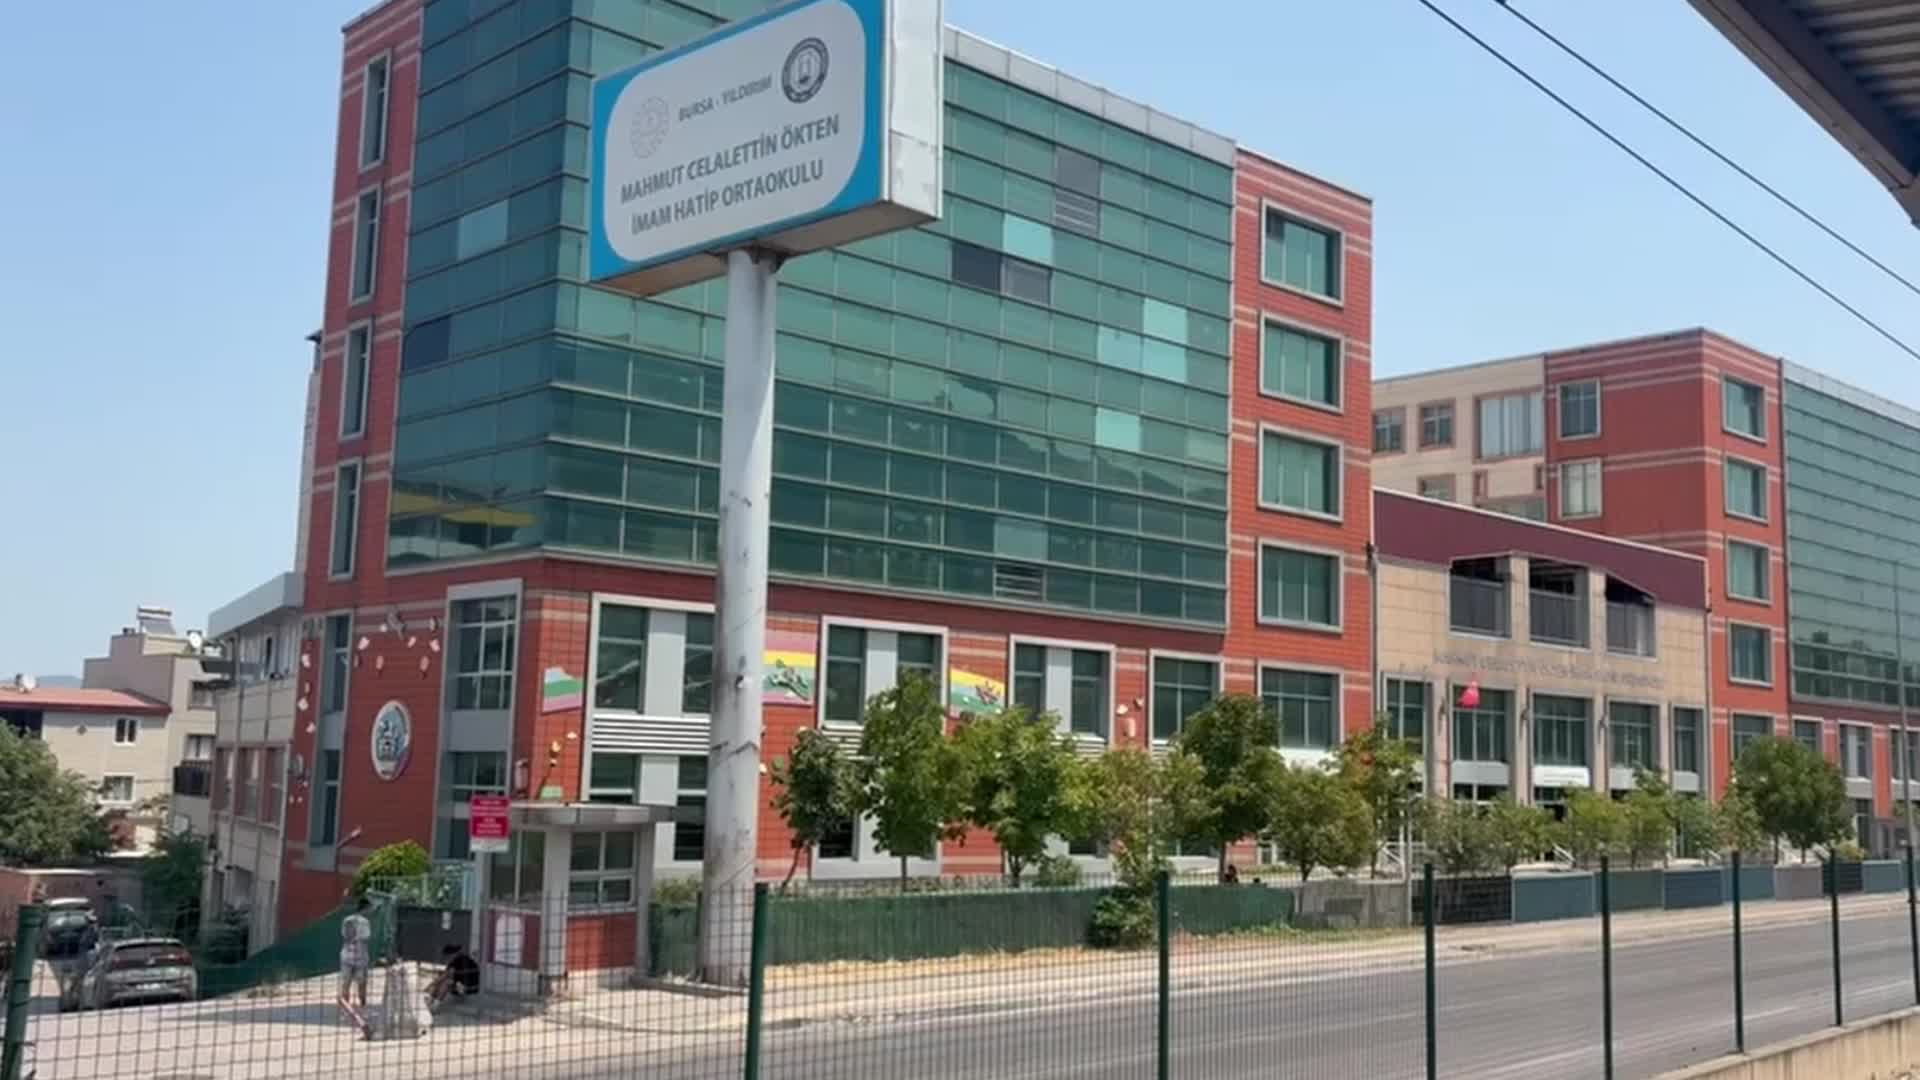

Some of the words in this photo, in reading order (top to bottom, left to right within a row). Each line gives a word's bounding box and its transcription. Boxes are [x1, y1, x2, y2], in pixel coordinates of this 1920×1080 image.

[679, 96, 714, 122] BURSA
[621, 165, 684, 203] MAHMUT
[687, 132, 778, 180] CELALETTİN
[782, 113, 839, 150] ÖKTEN
[631, 206, 672, 235] İMAM
[674, 187, 720, 221] HATİP
[722, 160, 823, 207] ORTAOKULU
